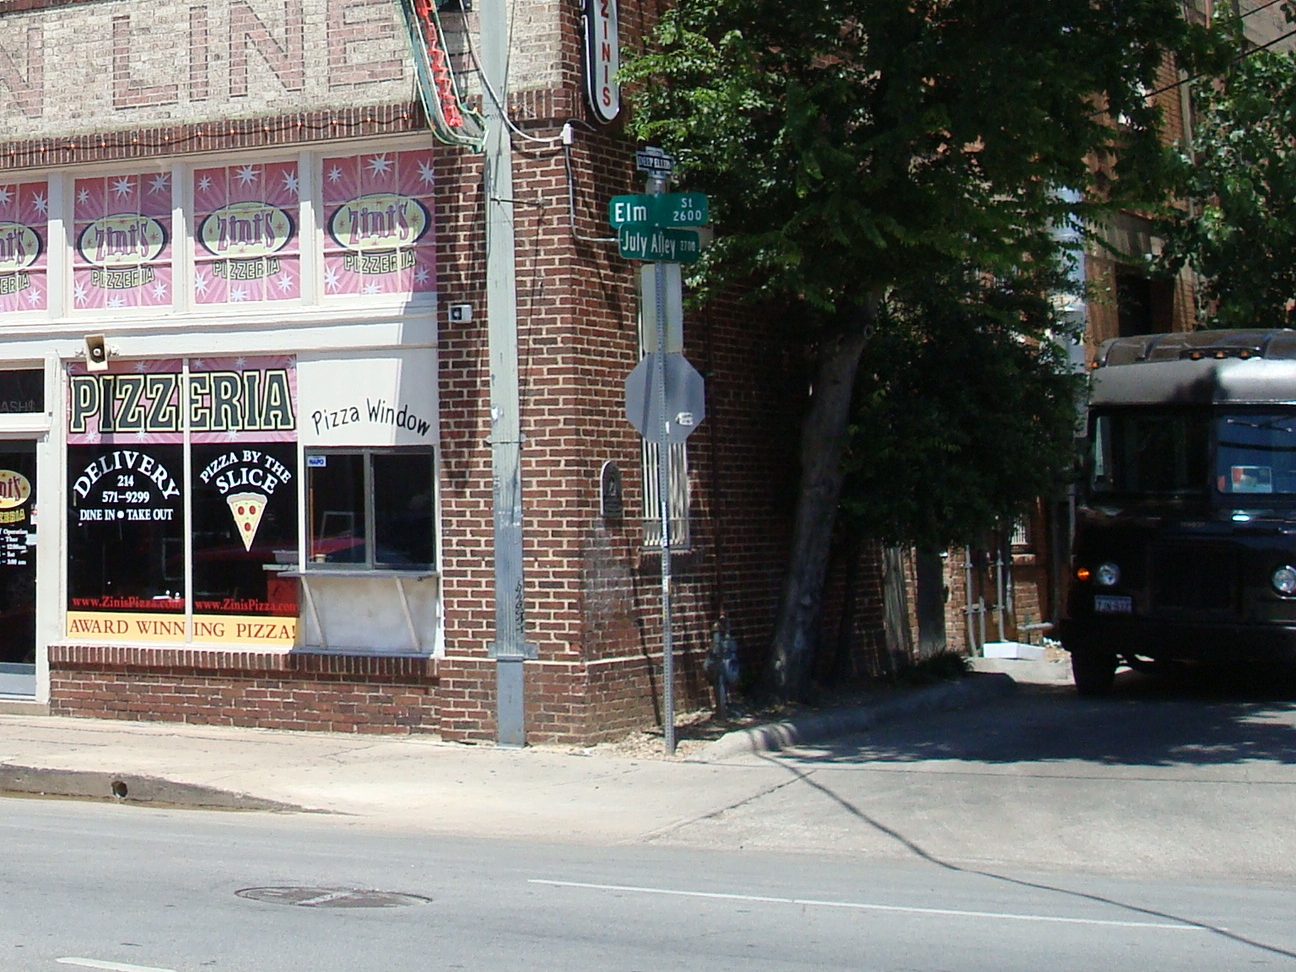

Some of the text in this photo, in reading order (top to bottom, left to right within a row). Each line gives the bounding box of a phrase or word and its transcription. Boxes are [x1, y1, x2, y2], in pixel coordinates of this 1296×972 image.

[614, 198, 692, 222] Elm St
[673, 210, 702, 221] 2600
[622, 231, 647, 257] July
[651, 232, 675, 259] Alley
[212, 256, 281, 280] PIZZERIA
[344, 248, 417, 275] PIZZERIA
[91, 265, 155, 290] PIZZERIA
[69, 369, 297, 433] PIZZERIA
[311, 398, 430, 436] Pizza Window
[73, 450, 180, 500] DELIVERY
[199, 449, 292, 485] PIZZA BY THE
[117, 474, 135, 487] 214
[215, 468, 279, 495] SLICE
[102, 490, 150, 503] 571-9299
[80, 508, 174, 521] DINE IN TAKE OUT
[72, 596, 183, 610] www.ZinisPizza.com
[70, 619, 129, 634] AWARD
[236, 623, 296, 640] PIZZA!
